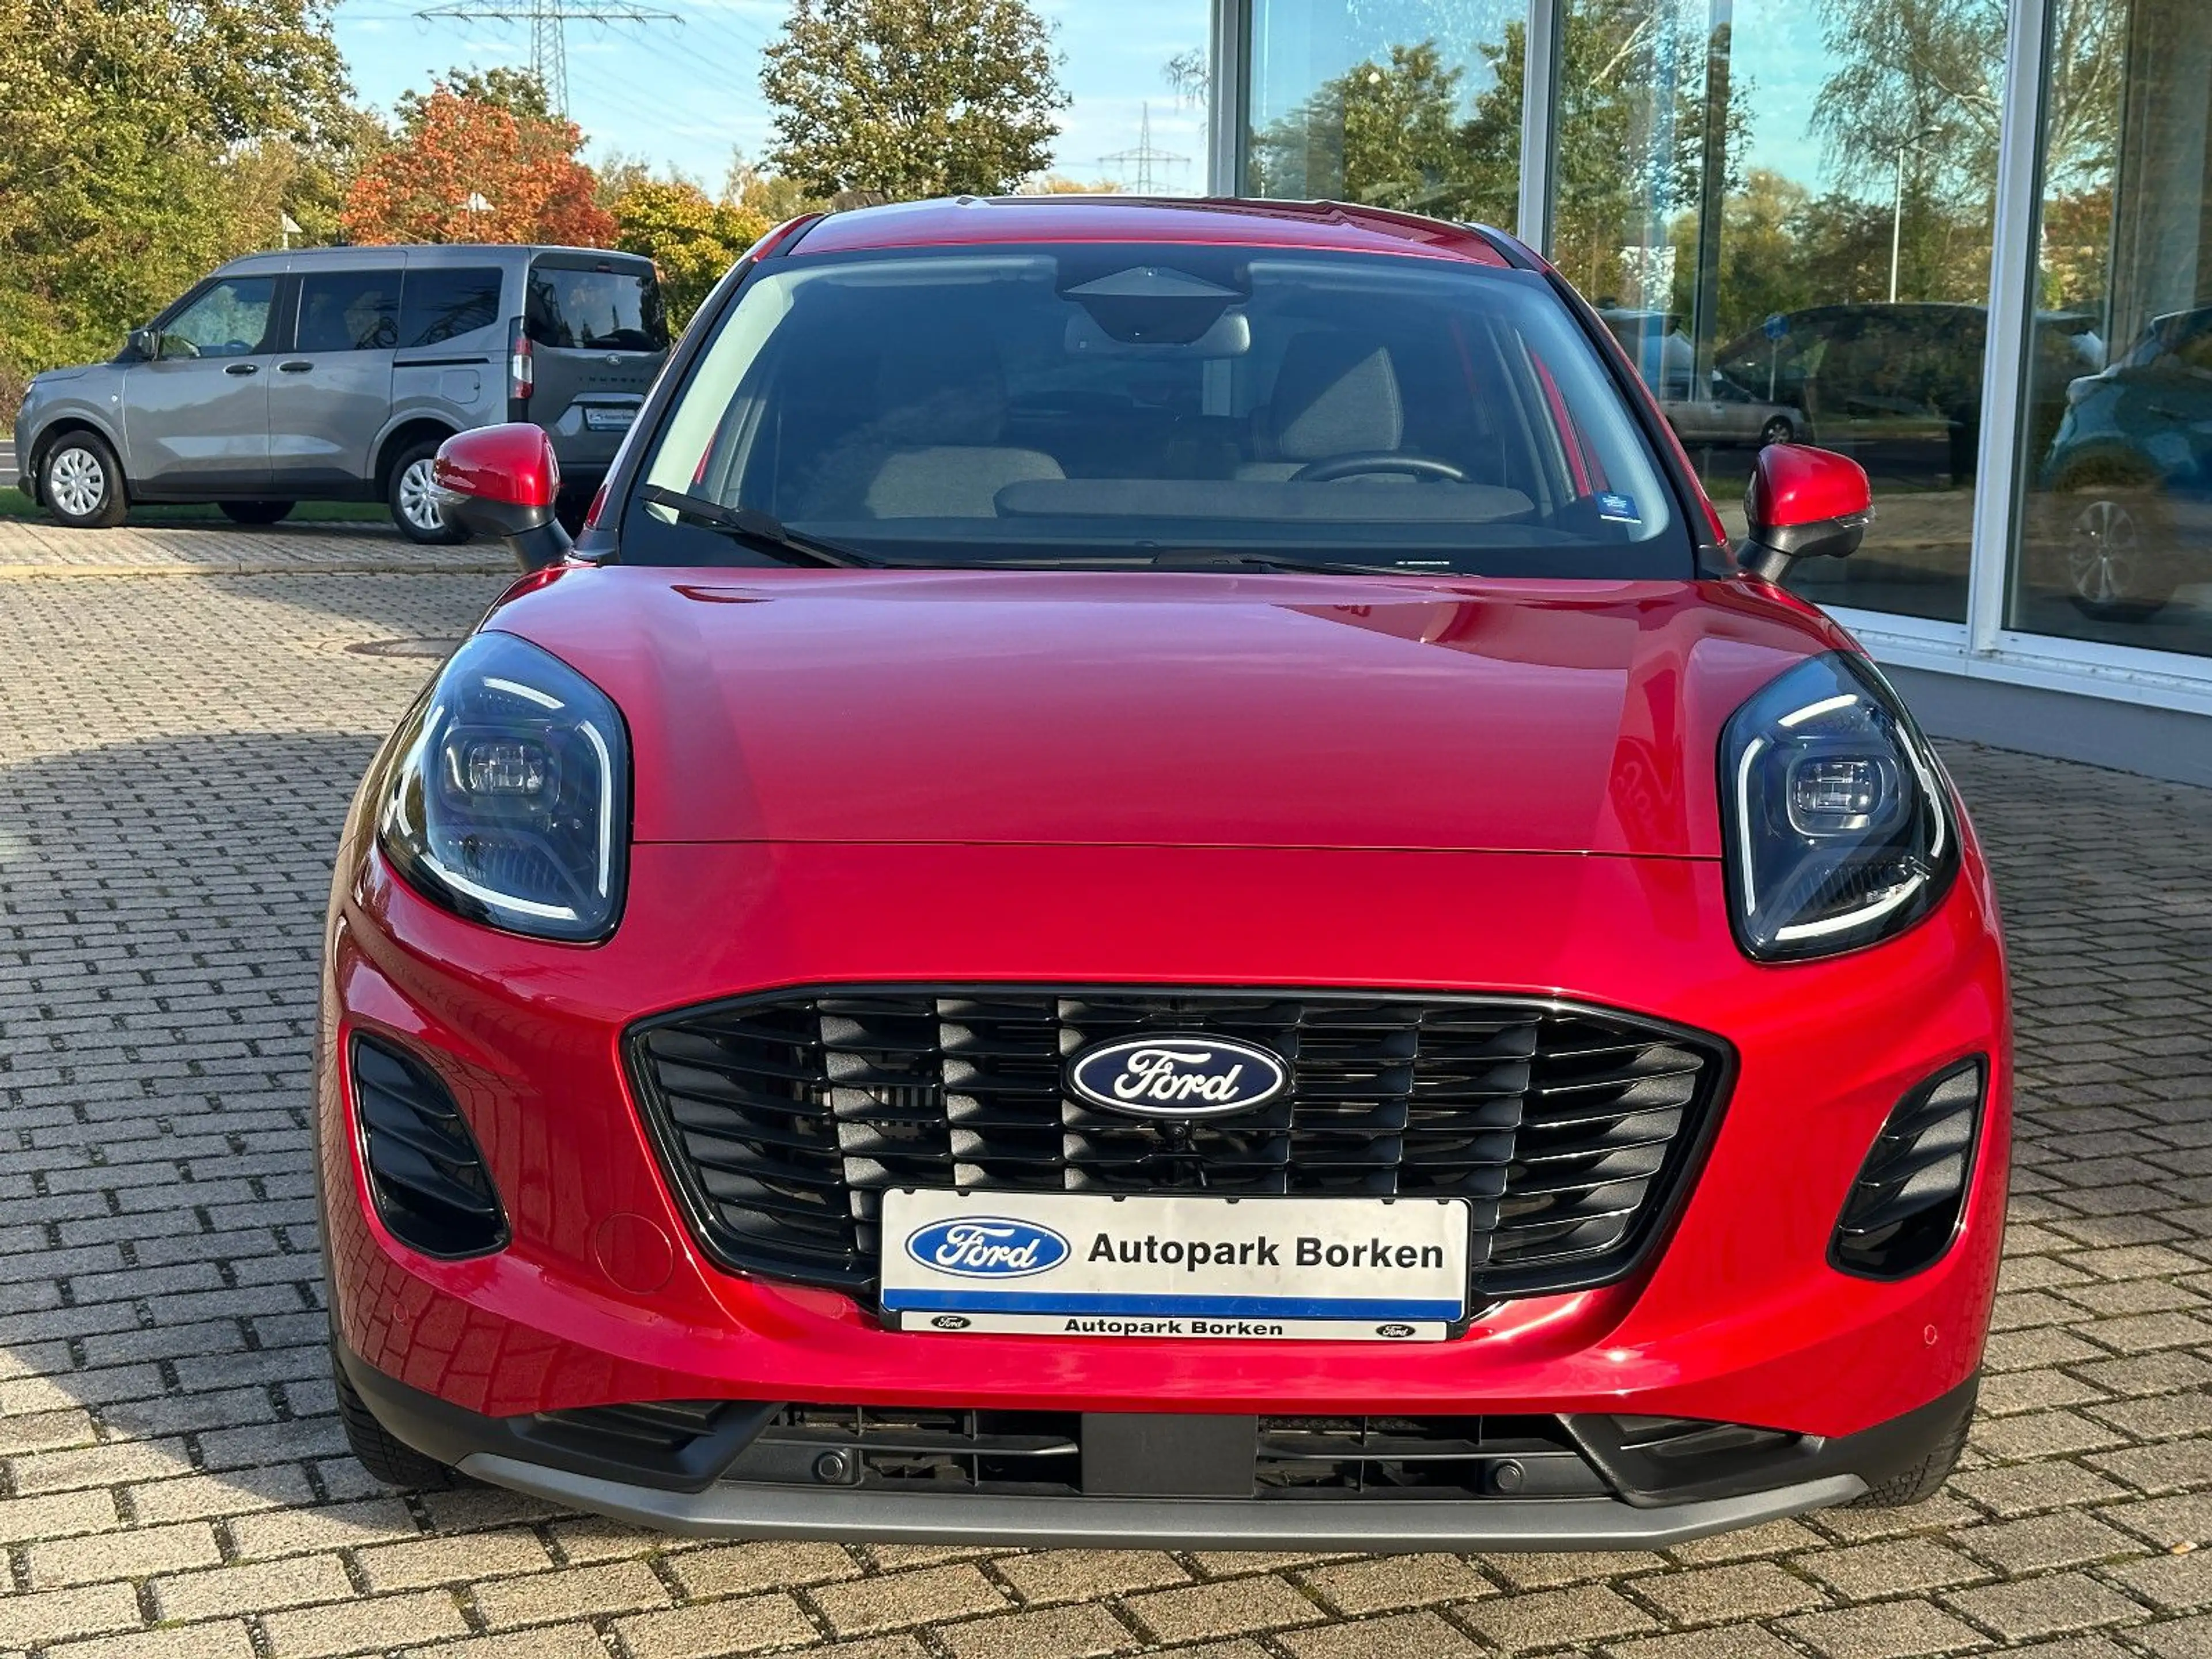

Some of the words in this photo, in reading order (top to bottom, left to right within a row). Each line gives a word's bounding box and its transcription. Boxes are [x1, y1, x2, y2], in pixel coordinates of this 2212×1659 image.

[1114, 1049, 1243, 1100] Ford
[935, 1225, 1040, 1267] Ford
[1088, 1233, 1279, 1271] Autopark
[1296, 1237, 1444, 1268] Borken
[938, 1317, 964, 1328] Ford
[1064, 1318, 1183, 1336] Autopark
[1191, 1321, 1283, 1335] Borken
[1382, 1325, 1408, 1336] Ford
